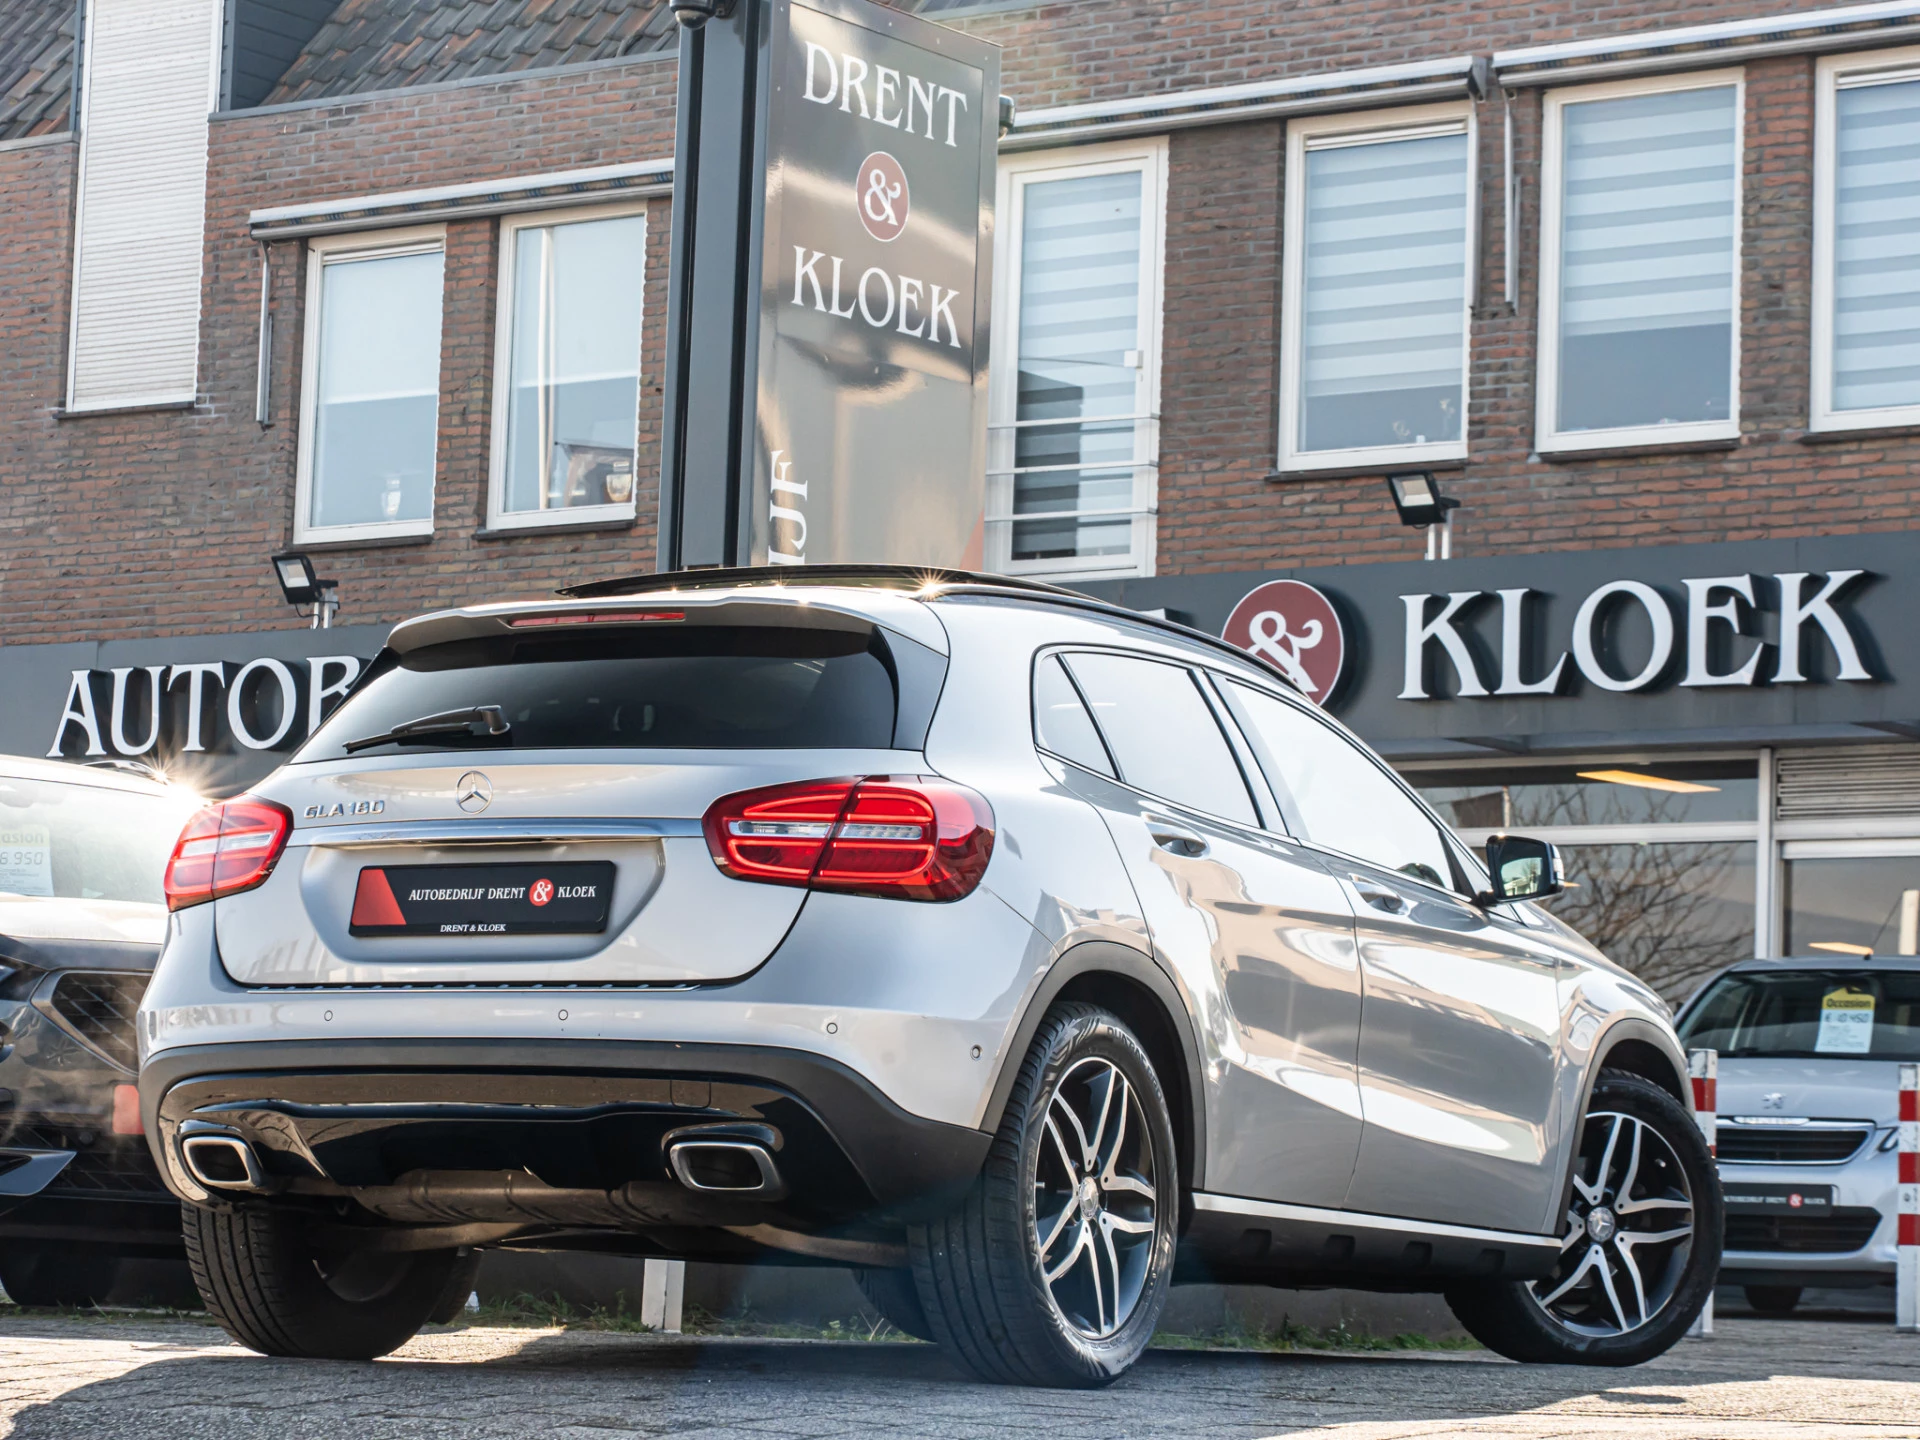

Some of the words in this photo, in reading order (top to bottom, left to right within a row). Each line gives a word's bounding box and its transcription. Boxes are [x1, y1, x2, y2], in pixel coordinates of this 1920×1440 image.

[802, 41, 968, 148] DRENT
[864, 168, 901, 226] &
[791, 244, 962, 350] KLOEK
[1396, 569, 1873, 700] KLOEK
[303, 803, 344, 819] GLA
[347, 799, 385, 816] 180
[408, 887, 485, 901] AUTOBEDRIJF
[487, 887, 526, 900] DRENT
[533, 881, 551, 902] &
[557, 885, 597, 898] KLOEK
[440, 924, 469, 933] DRENT
[469, 924, 476, 932] &
[477, 923, 506, 932] KLOEK
